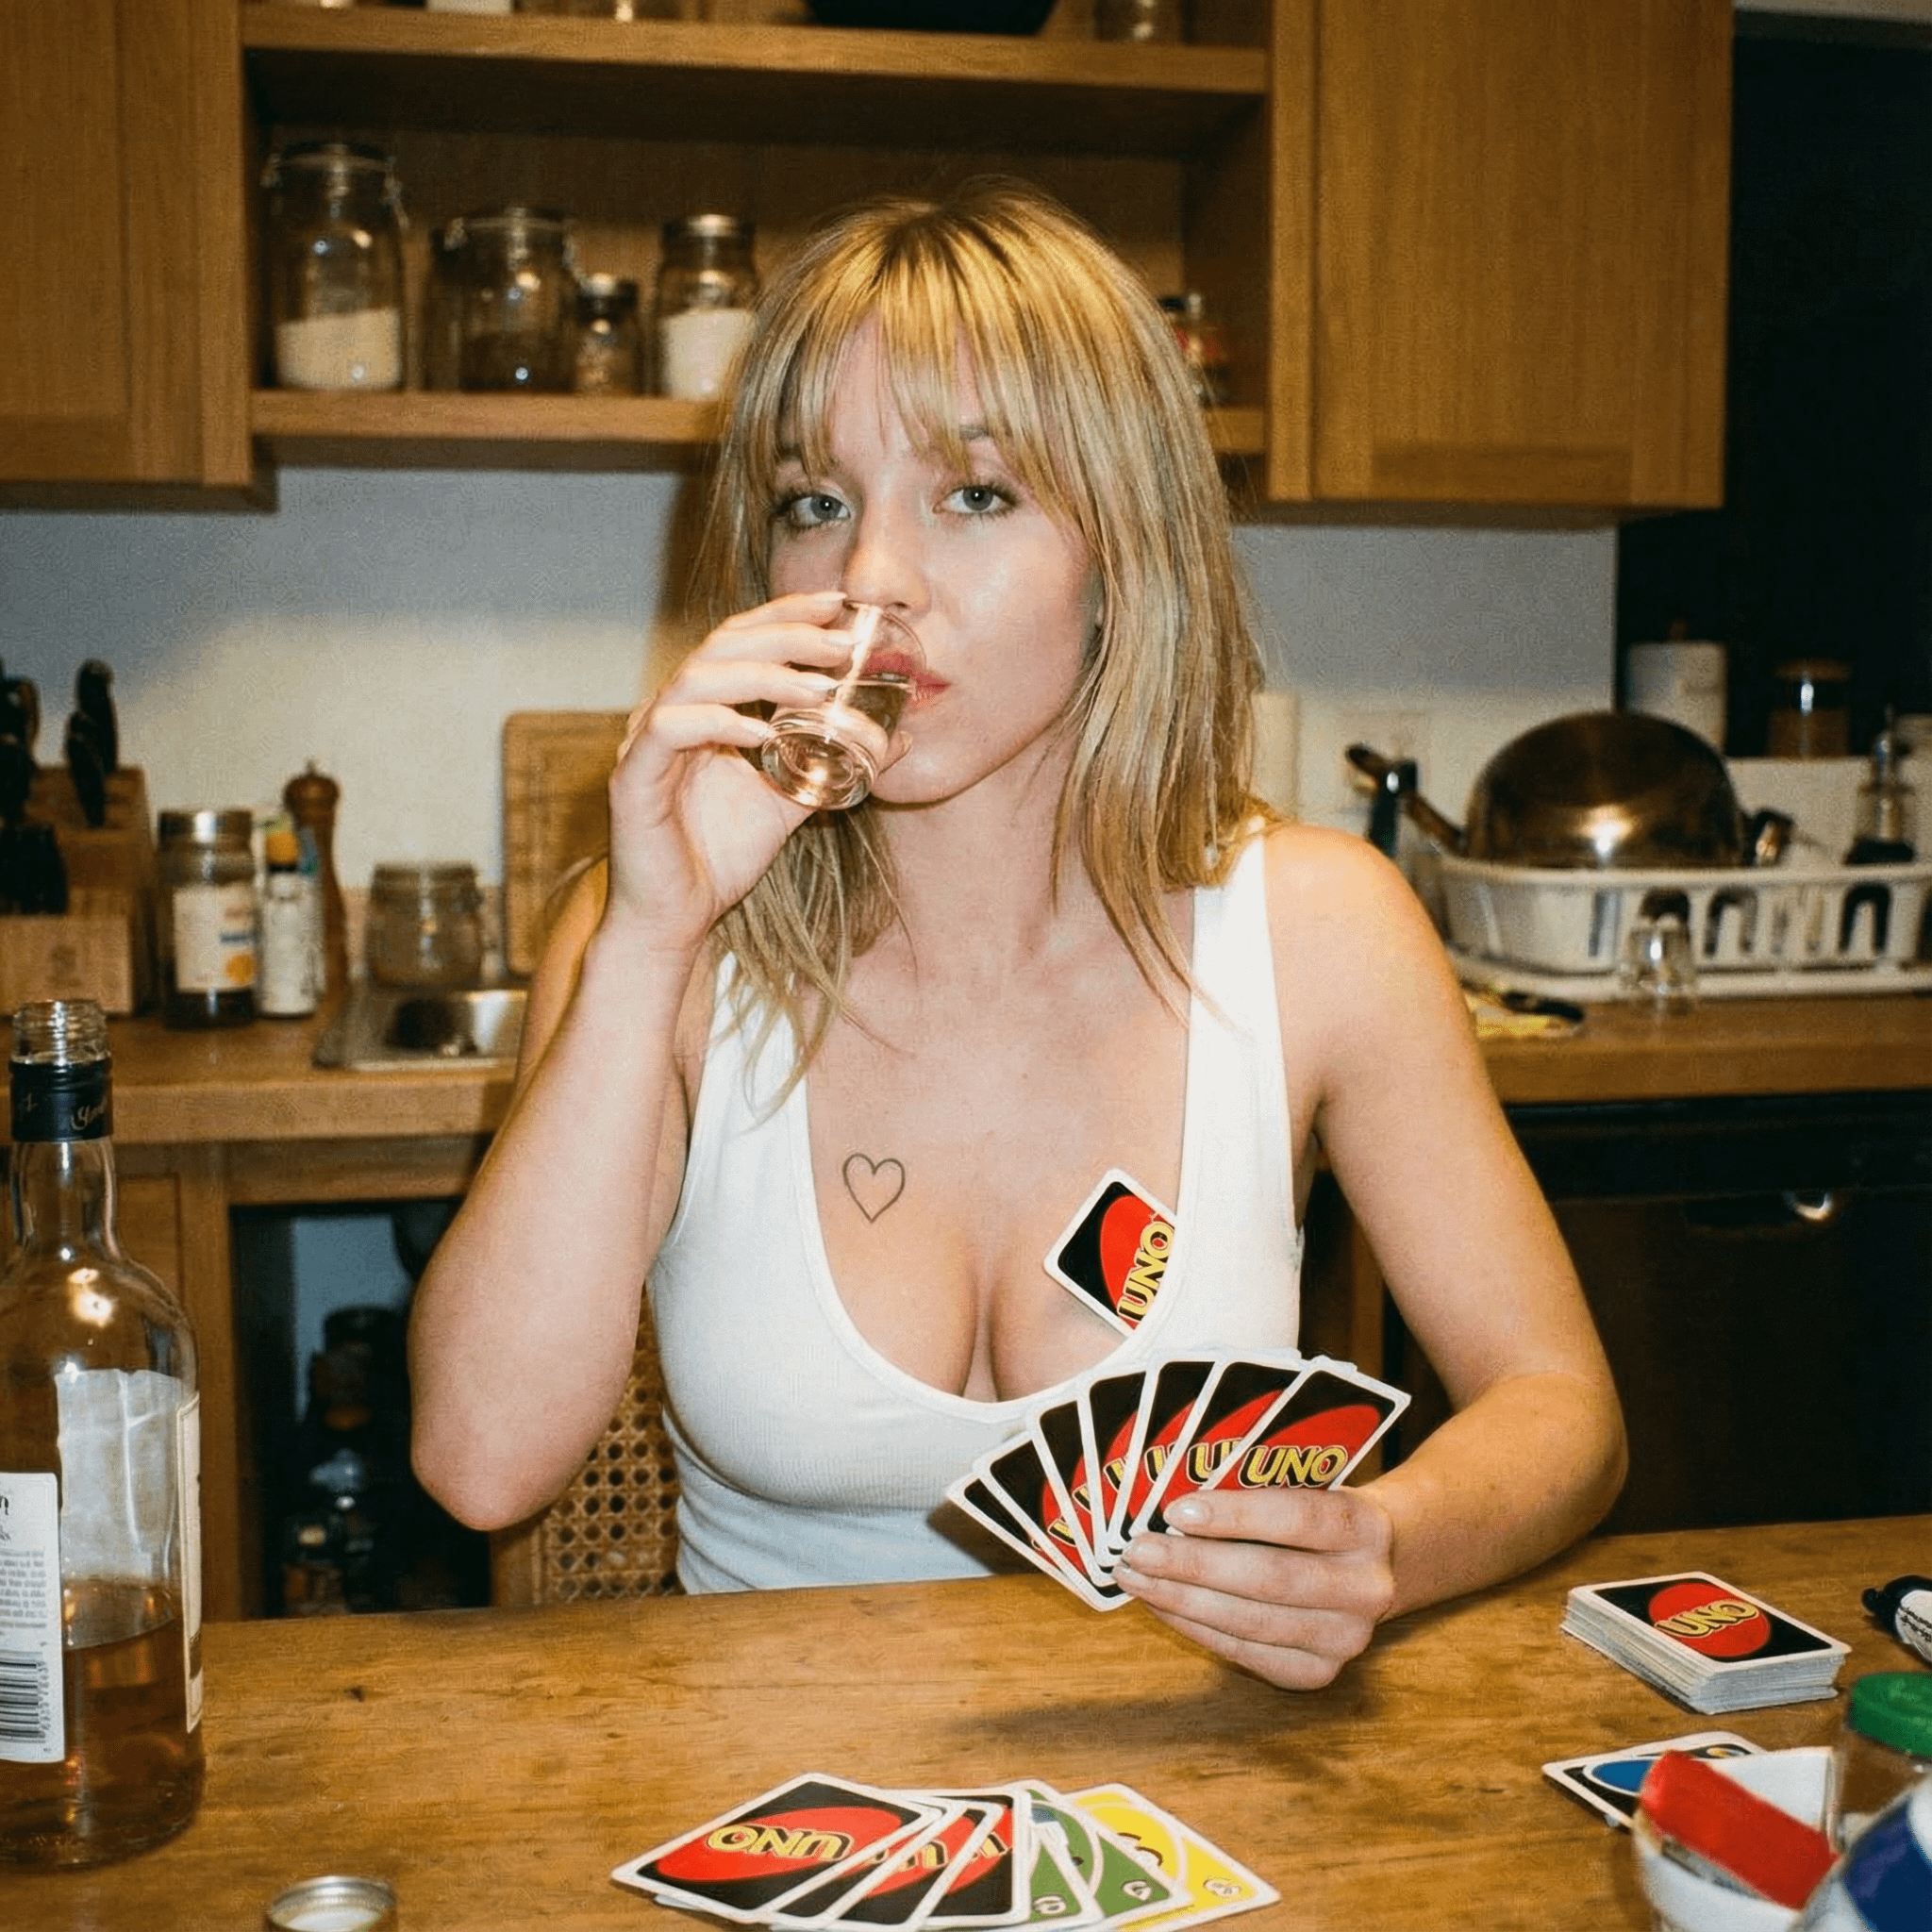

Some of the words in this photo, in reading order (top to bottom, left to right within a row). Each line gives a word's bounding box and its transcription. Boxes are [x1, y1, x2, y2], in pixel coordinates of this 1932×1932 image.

[1117, 1221, 1174, 1322] UNO
[1238, 1445, 1348, 1488] UNO
[1654, 1600, 1759, 1639] UNO
[705, 1824, 856, 1861] UNO
